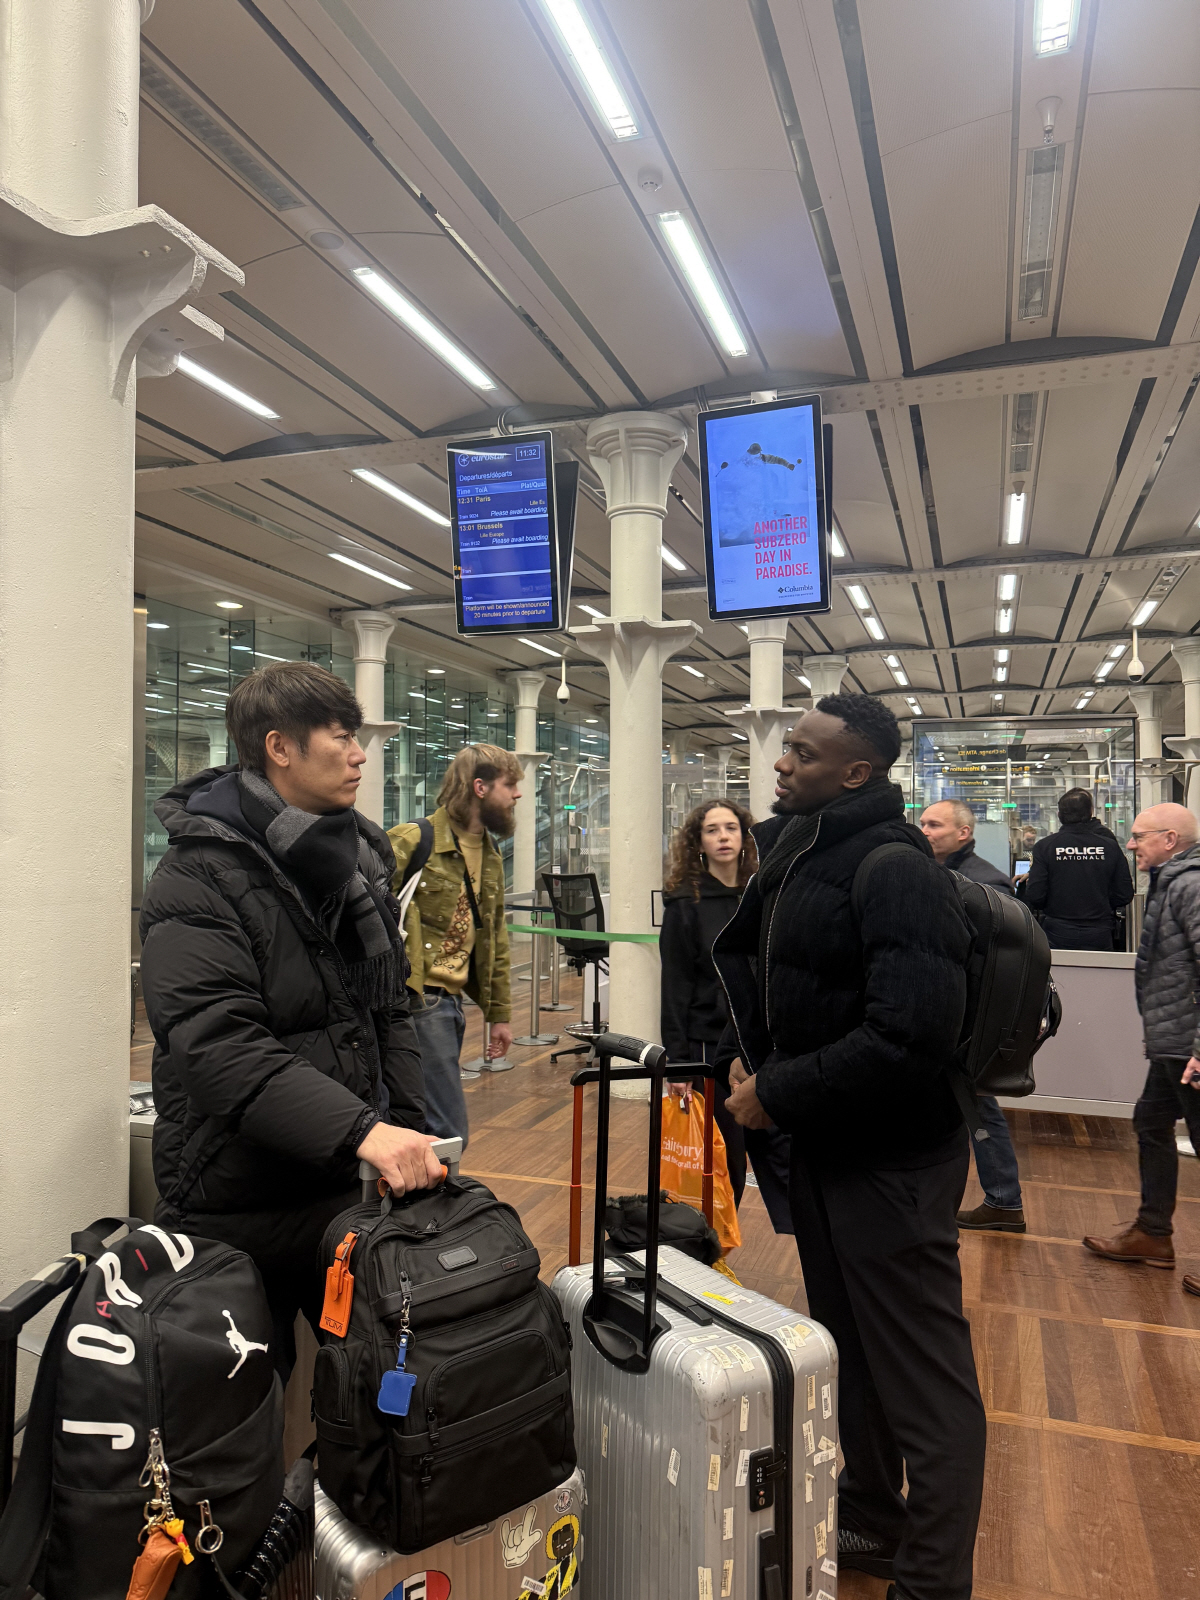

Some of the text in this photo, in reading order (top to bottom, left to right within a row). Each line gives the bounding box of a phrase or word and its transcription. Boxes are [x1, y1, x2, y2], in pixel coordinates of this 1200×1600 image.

[519, 449, 537, 457] 11:32
[520, 481, 546, 489] Plat/Quai
[477, 522, 503, 530] Brussels
[754, 516, 807, 534] ANOTHER
[526, 534, 548, 542] boarding
[754, 531, 807, 550] SUBZERO
[755, 548, 792, 565] DAY IN
[756, 562, 813, 580] PARADISE.
[785, 584, 813, 592] Columbia
[503, 601, 550, 609] shown/announced
[521, 608, 546, 617] departure
[1055, 846, 1105, 856] POLICE
